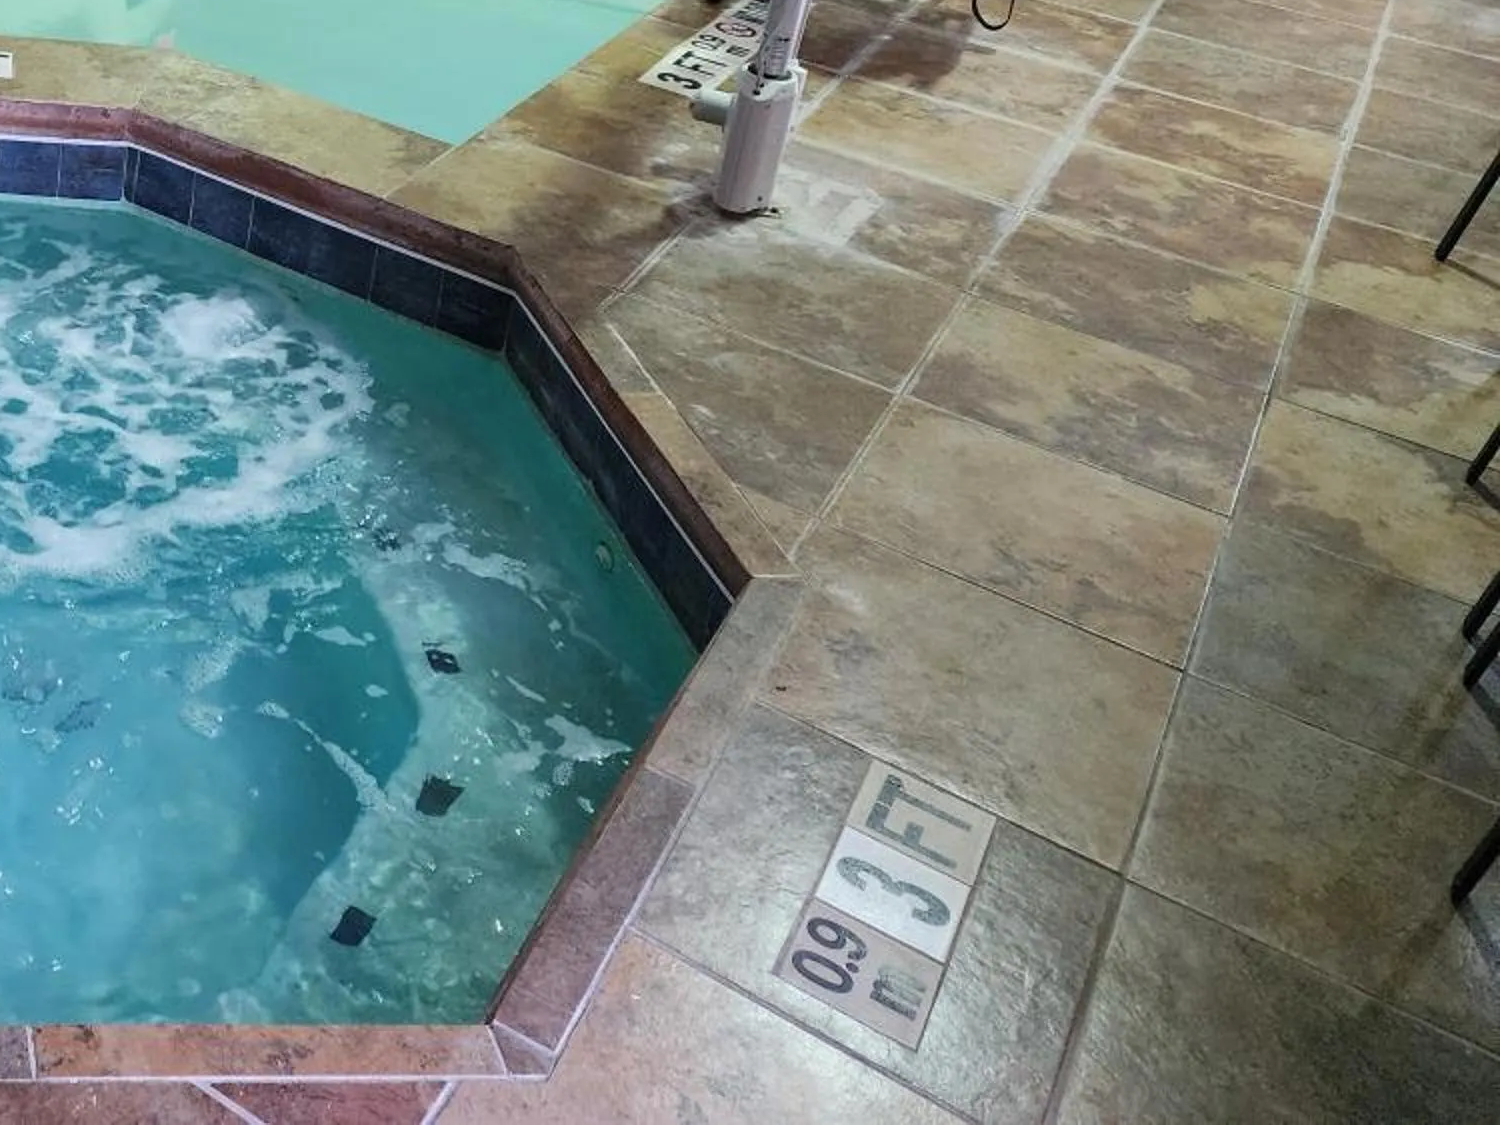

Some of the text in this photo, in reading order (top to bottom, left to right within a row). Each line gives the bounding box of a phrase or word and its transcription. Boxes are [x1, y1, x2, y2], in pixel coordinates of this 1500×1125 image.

[672, 50, 730, 77] FT
[657, 72, 702, 90] 3
[791, 774, 971, 994] 0.9 3 FT
